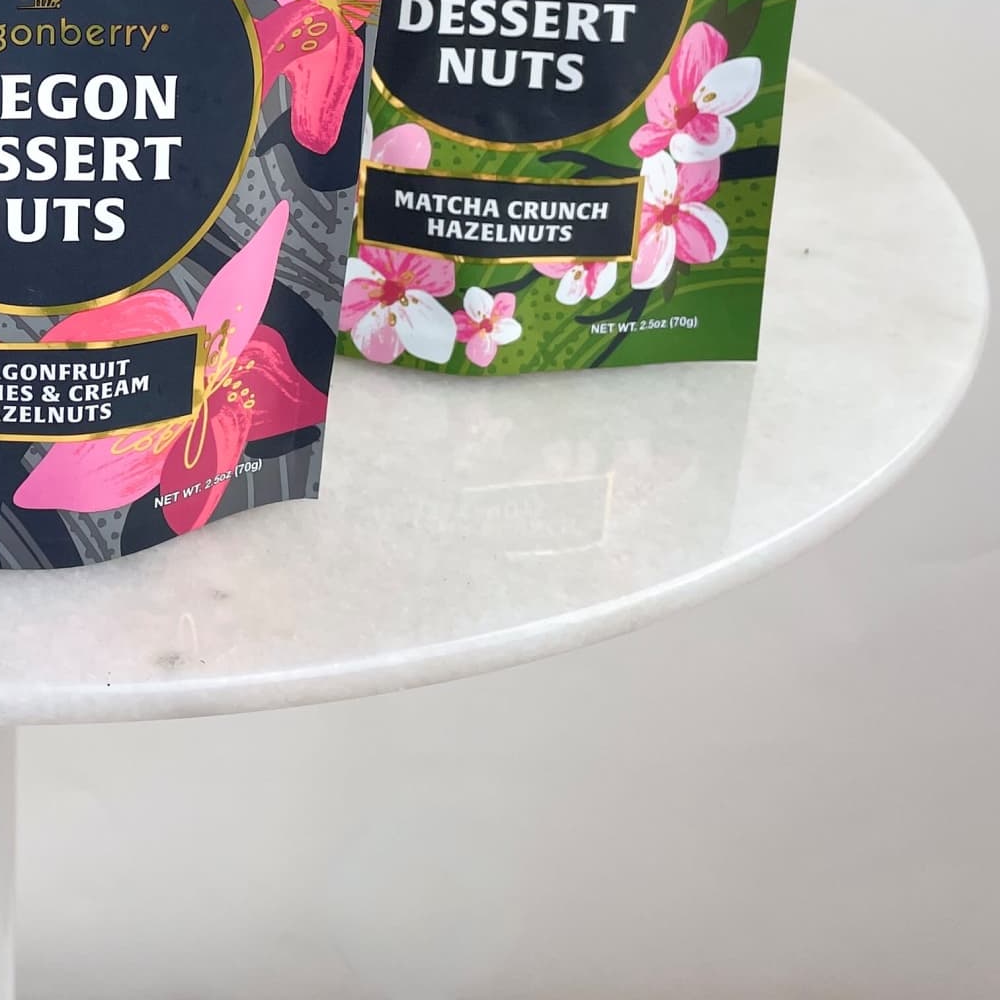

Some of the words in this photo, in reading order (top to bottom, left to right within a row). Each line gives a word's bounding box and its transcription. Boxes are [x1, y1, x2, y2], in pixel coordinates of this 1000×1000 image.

[437, 46, 585, 92] NUTS
[394, 189, 500, 218] MATCHA
[507, 200, 609, 220] CRUNCH
[427, 217, 573, 243] HAZELNUTS
[590, 322, 616, 335] NET
[668, 315, 699, 330] (70g)
[41, 385, 61, 402] &
[68, 375, 150, 402] CREAM
[153, 491, 180, 509] NET
[233, 457, 263, 479] (70g)
